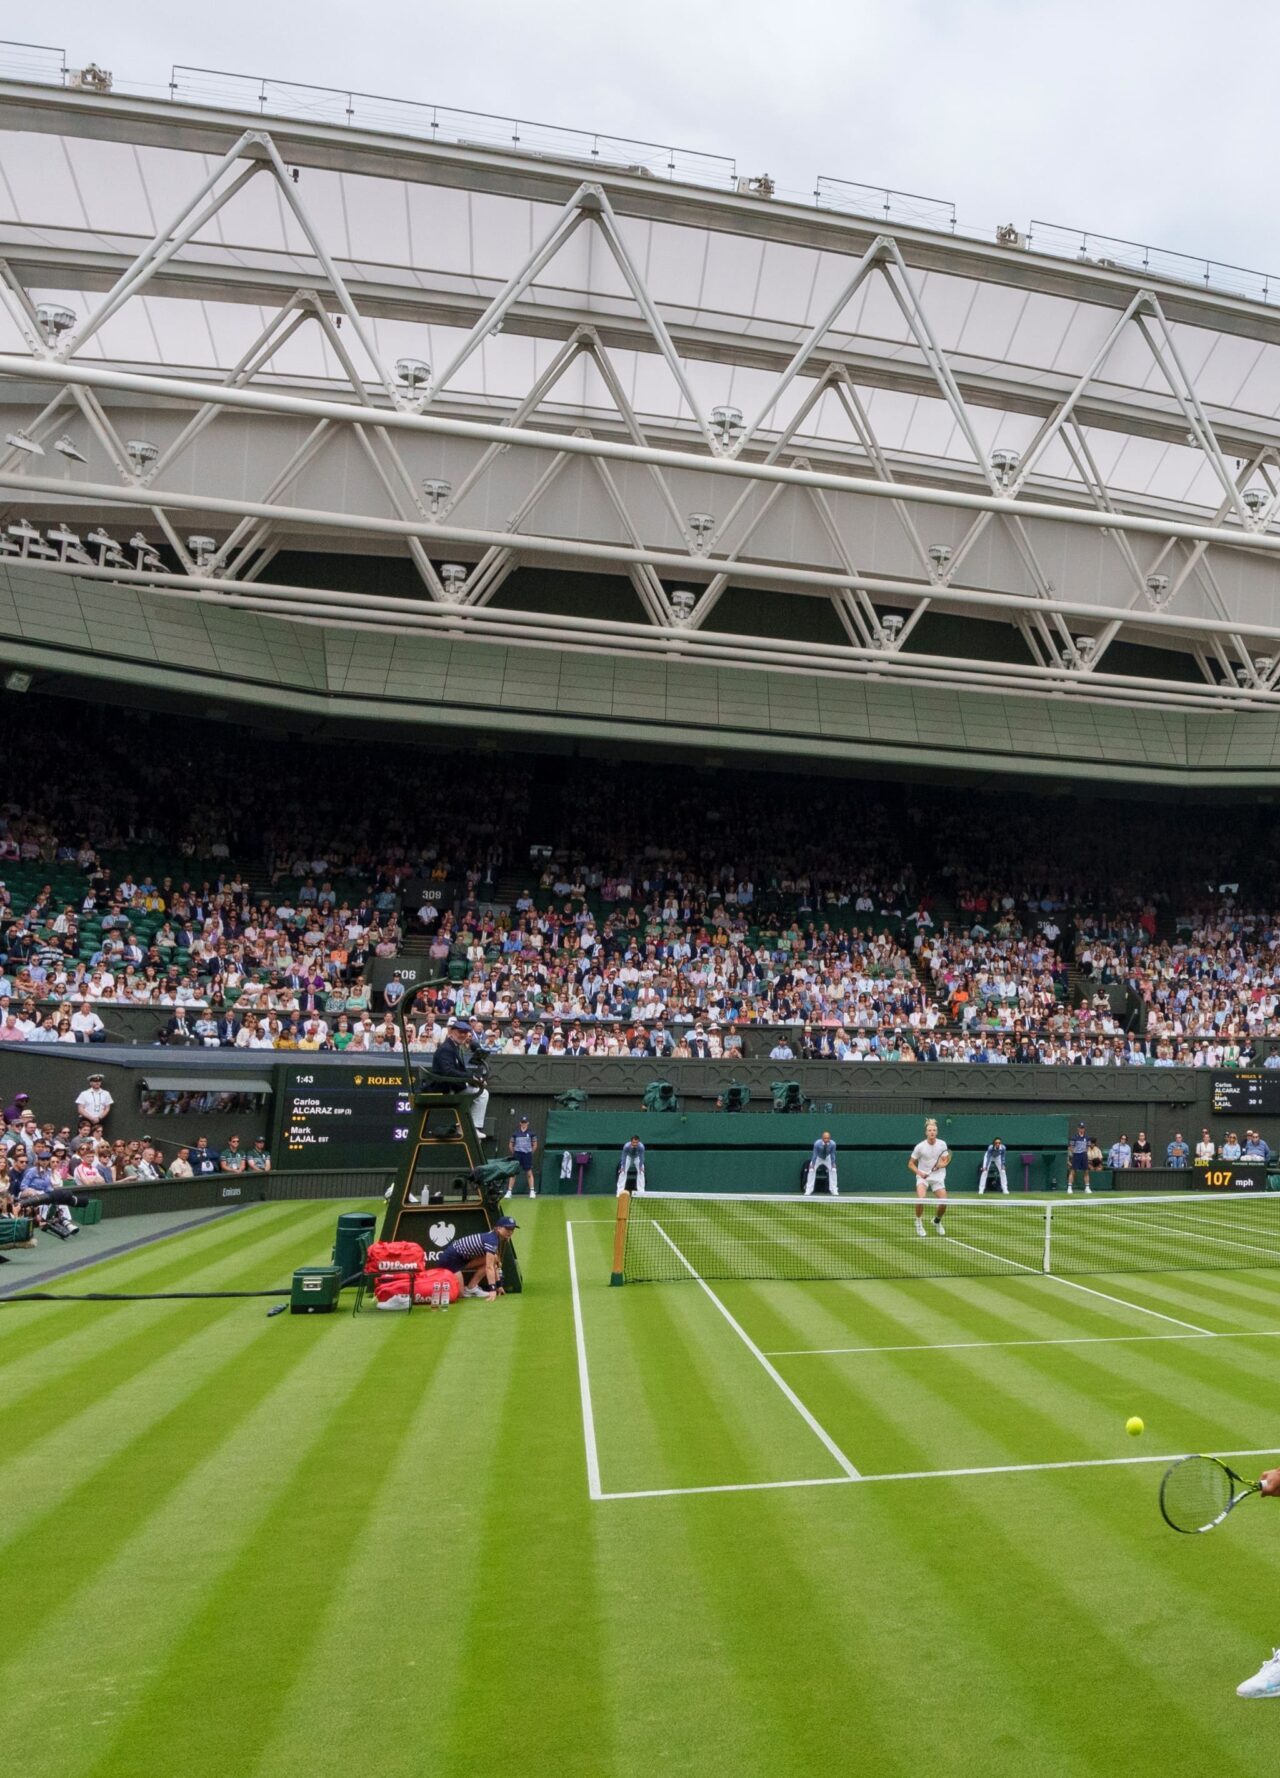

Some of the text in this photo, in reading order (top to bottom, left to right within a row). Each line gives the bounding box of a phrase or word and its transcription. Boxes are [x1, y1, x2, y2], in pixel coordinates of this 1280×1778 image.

[422, 890, 442, 899] 309
[1093, 993, 1110, 1001] 27
[296, 1075, 314, 1083] 1:43
[367, 1076, 402, 1085] ROLEX
[293, 1098, 320, 1106] Carlos
[292, 1106, 332, 1114] ALCARAZ
[397, 1102, 411, 1111] 30
[290, 1126, 311, 1134] Mark
[289, 1135, 316, 1143] LAJAL
[395, 1129, 409, 1138] 30
[1205, 1171, 1254, 1187] 107 mph
[378, 1260, 418, 1271] Wilson
